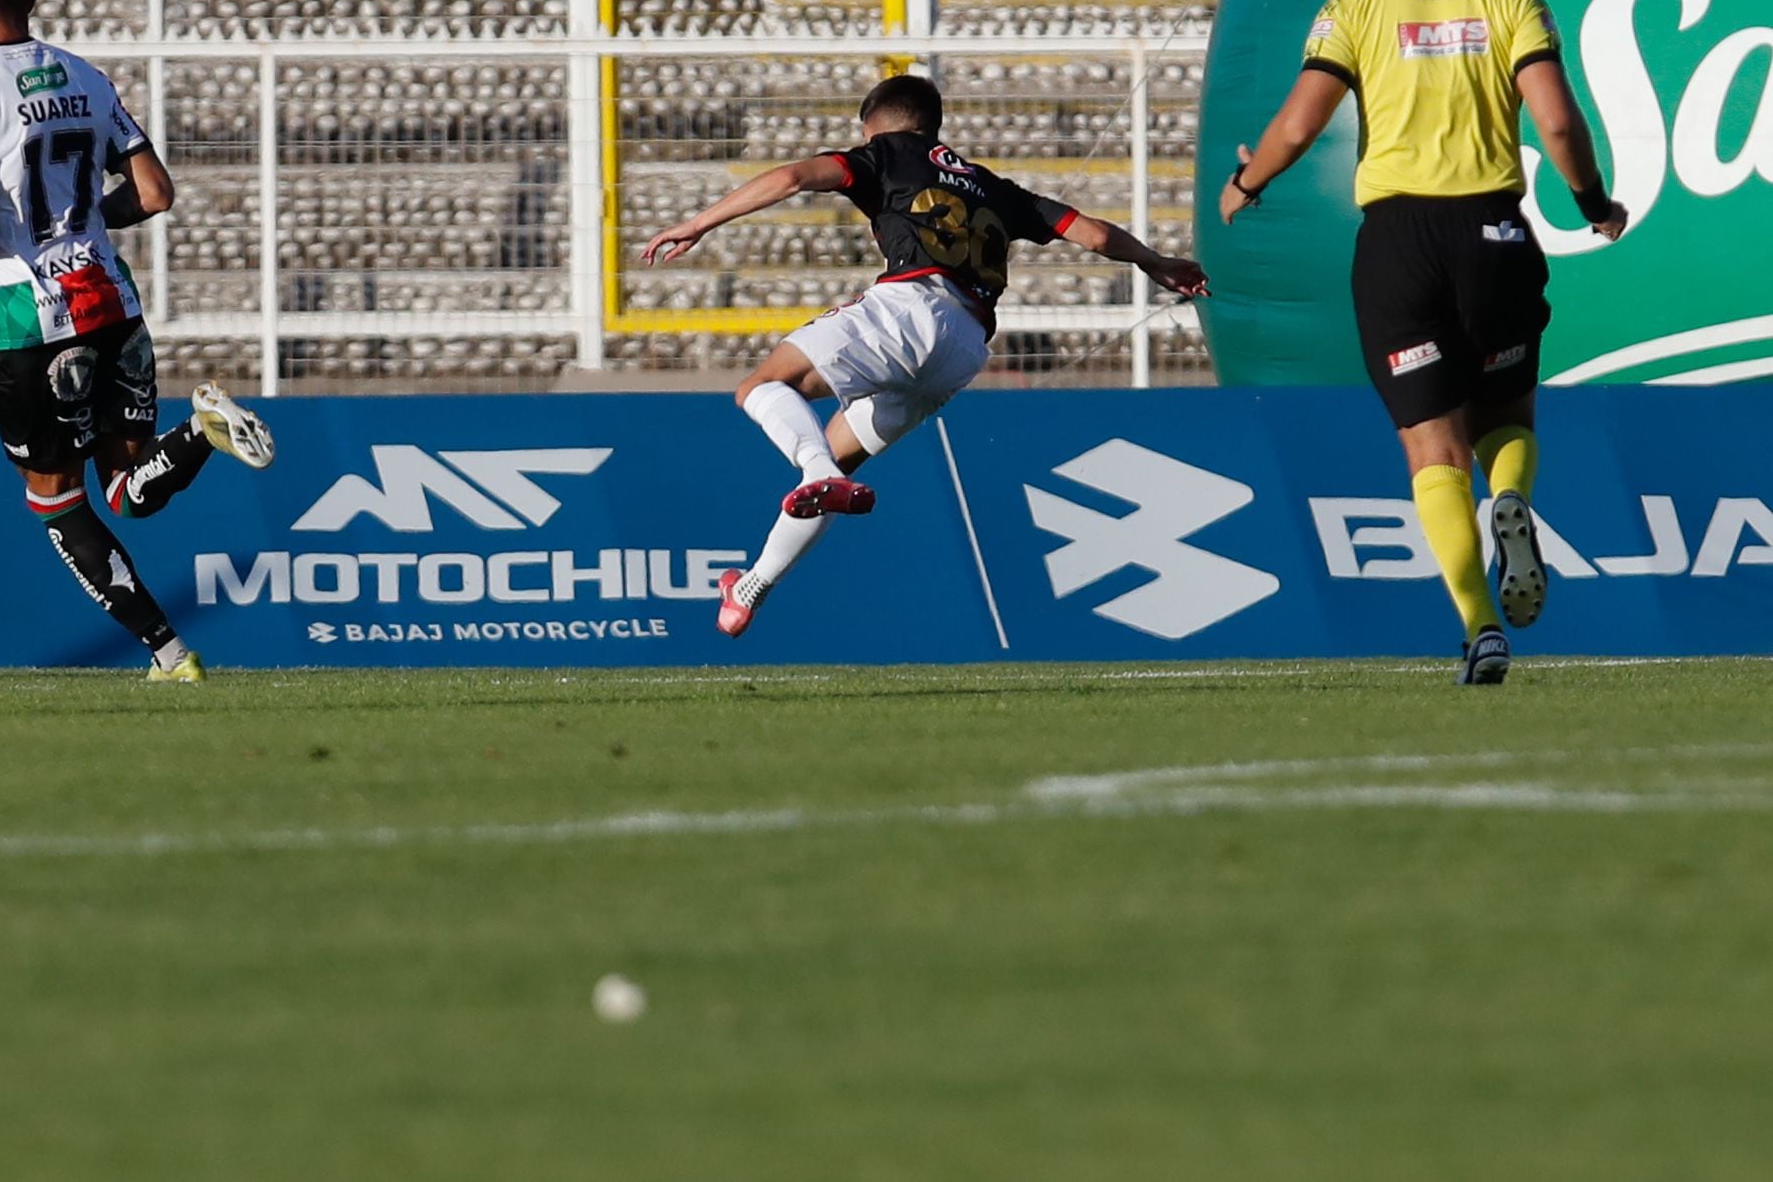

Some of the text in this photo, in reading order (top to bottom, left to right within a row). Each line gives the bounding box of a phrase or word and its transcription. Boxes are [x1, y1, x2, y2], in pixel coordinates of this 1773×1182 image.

[1418, 21, 1487, 45] MTS
[17, 95, 91, 125] SUAREZ
[22, 128, 95, 245] 17
[30, 247, 105, 279] KAYSR
[1397, 341, 1438, 366] MTS
[124, 406, 155, 421] UAZ
[47, 527, 106, 603] Continental
[194, 548, 747, 606] MOTOCHILE
[344, 618, 669, 643] BAJAJ MOTORCYCLE
